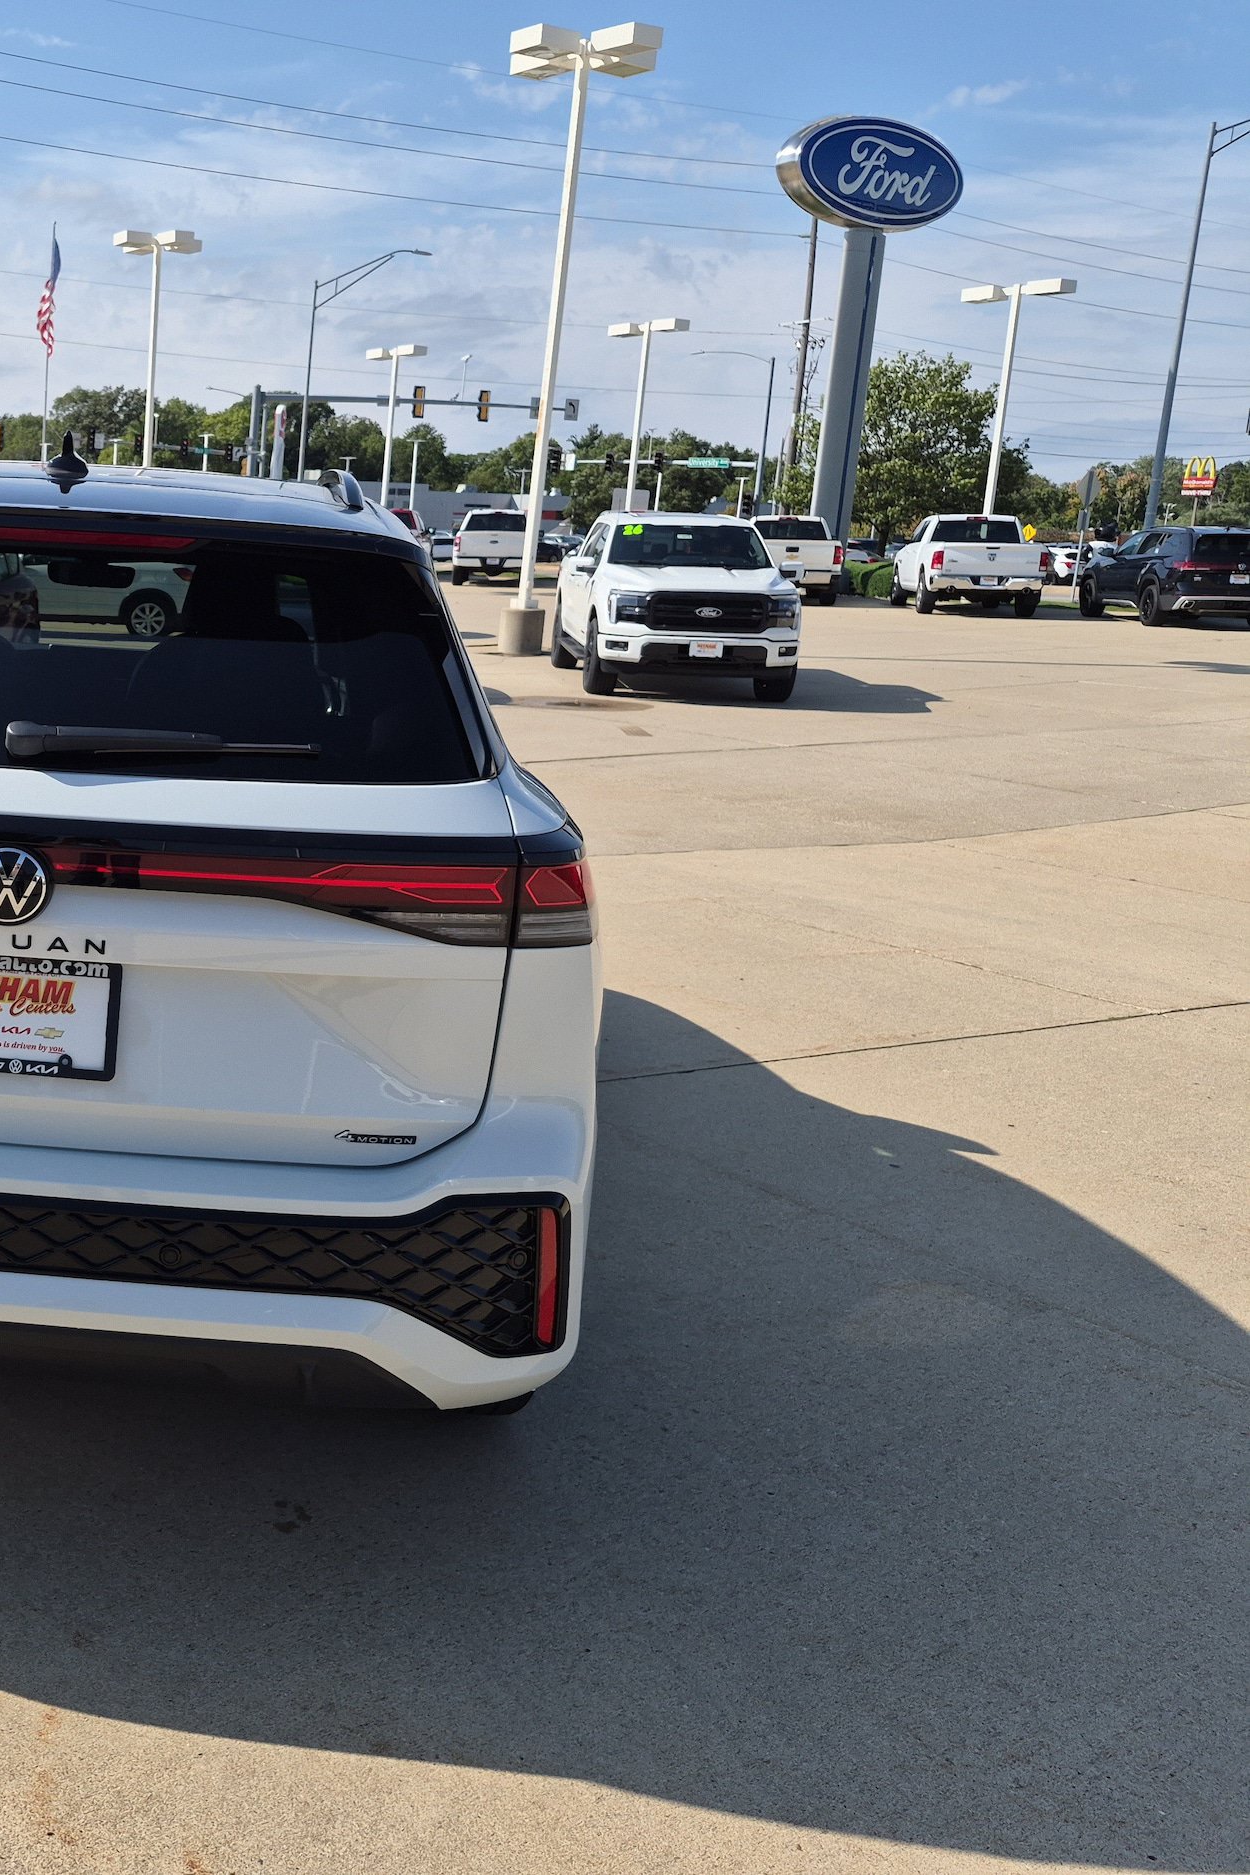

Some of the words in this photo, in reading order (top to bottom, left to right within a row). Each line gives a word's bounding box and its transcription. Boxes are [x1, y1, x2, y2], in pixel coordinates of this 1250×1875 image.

[837, 135, 937, 207] Ford
[622, 524, 644, 536] 26
[10, 996, 77, 1016] Centers
[3, 1040, 10, 1048] is
[11, 1041, 37, 1050] driven
[38, 1043, 48, 1053] by
[48, 1046, 66, 1054] you.
[334, 1129, 416, 1145] 4MOTION
